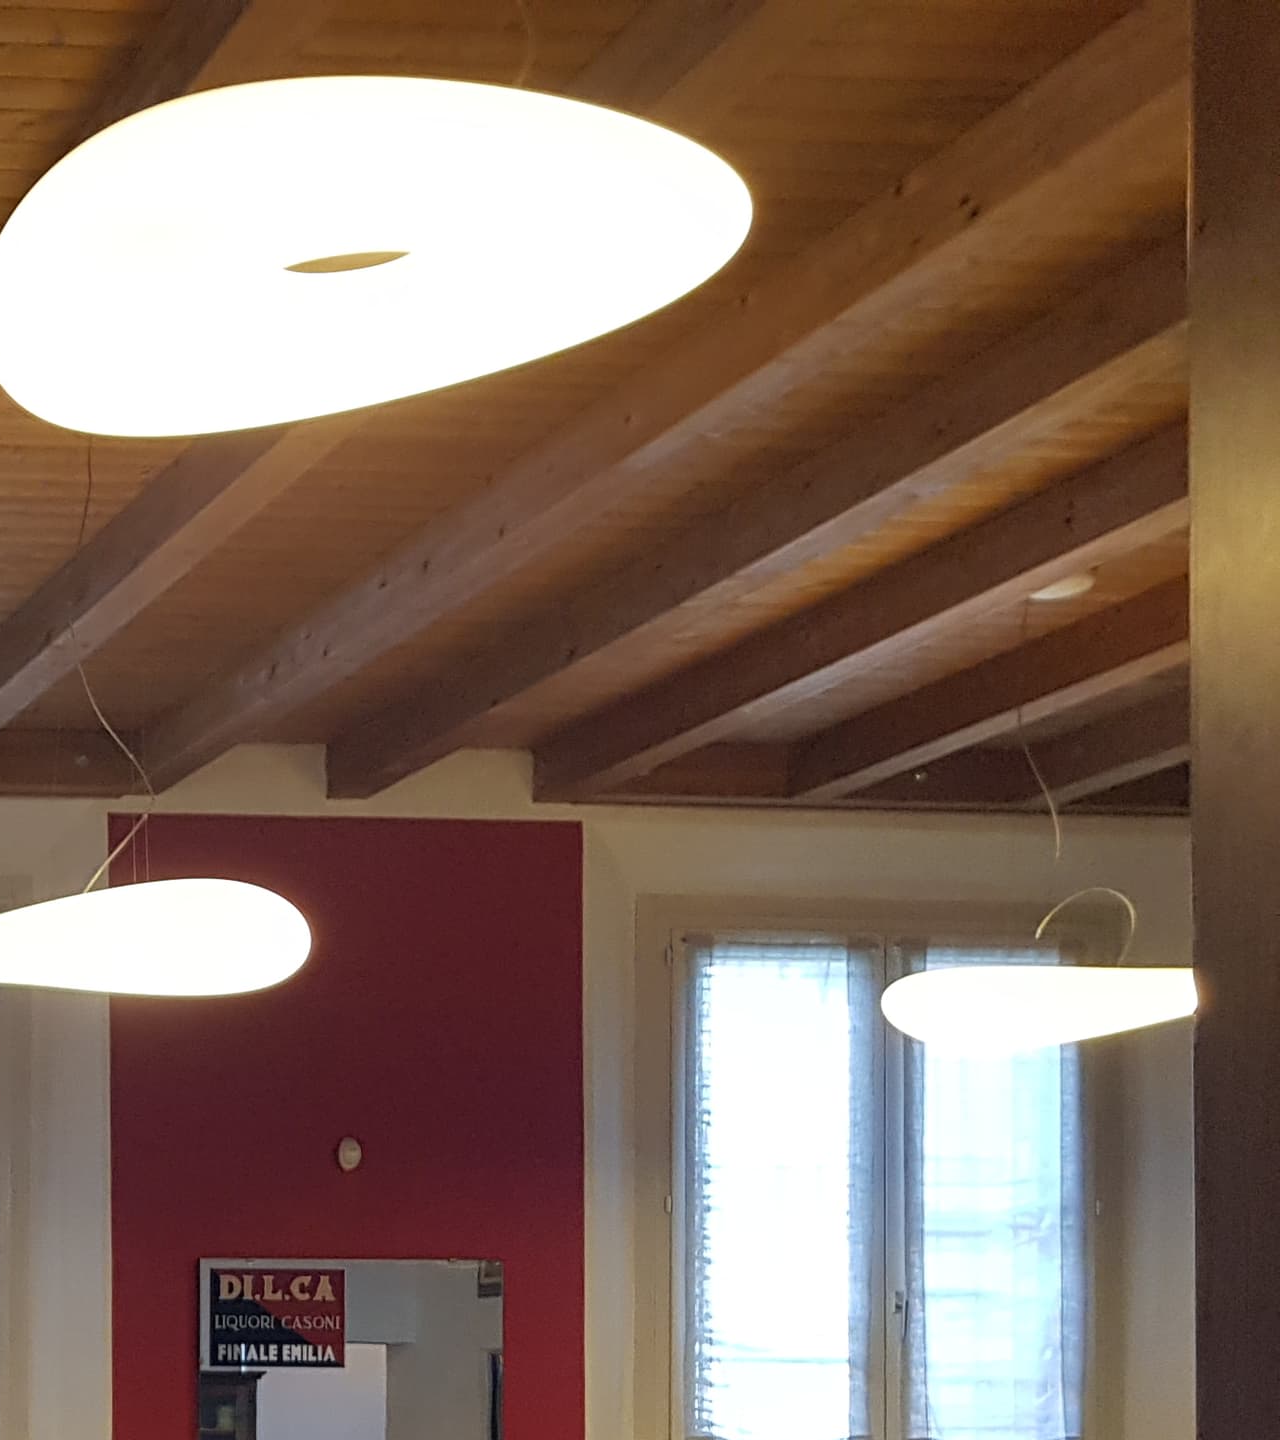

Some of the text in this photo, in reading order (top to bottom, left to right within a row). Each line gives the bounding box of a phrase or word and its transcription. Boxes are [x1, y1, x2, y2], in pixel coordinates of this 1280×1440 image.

[215, 1314, 340, 1331] LIQUORI CASONI
[217, 1344, 336, 1362] FINALE EMILIA
